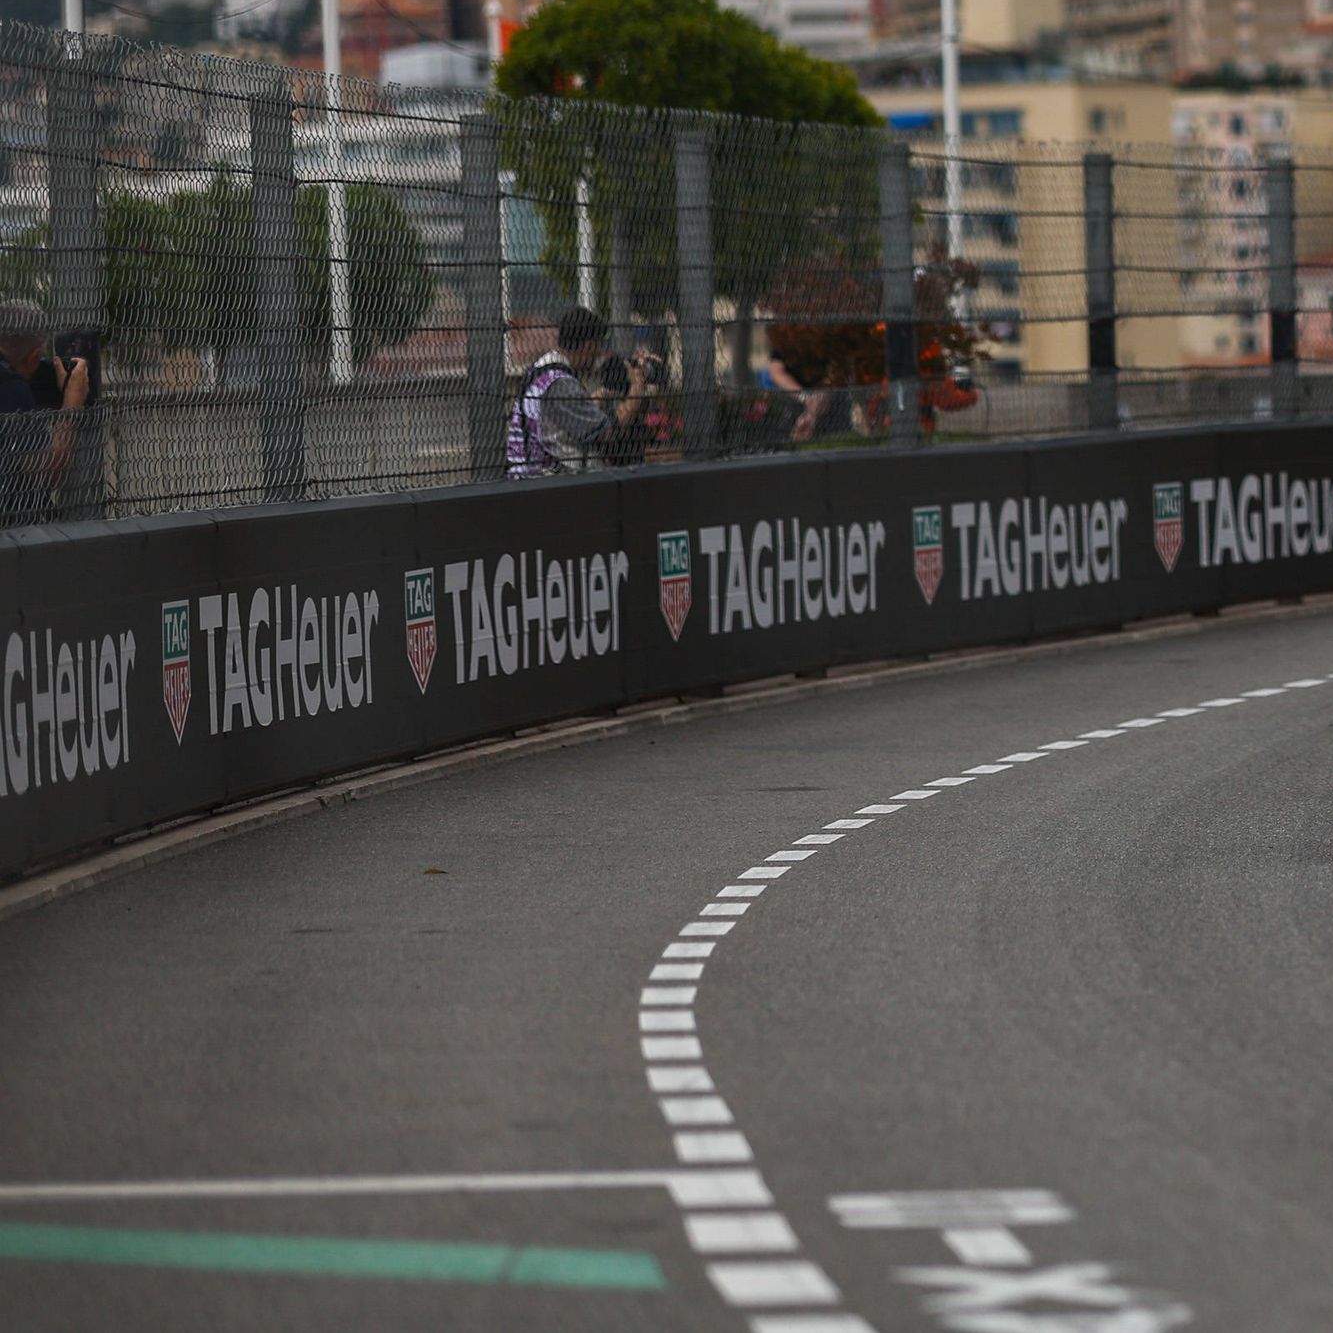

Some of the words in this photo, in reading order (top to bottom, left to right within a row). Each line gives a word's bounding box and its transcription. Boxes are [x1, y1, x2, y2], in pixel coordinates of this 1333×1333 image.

[915, 514, 941, 542] TAG
[1155, 489, 1181, 515] TAG
[661, 538, 689, 573] TAG
[951, 495, 1128, 601] TAGHeuer
[407, 580, 432, 615] TAG
[699, 517, 886, 635] TAGHeuer
[164, 610, 189, 654] TAG
[444, 549, 630, 685] TAGHeuer
[662, 581, 690, 632] HEUER
[199, 583, 379, 735] TAGHeuer
[408, 624, 435, 681] HEUER
[164, 667, 191, 736] HEUER
